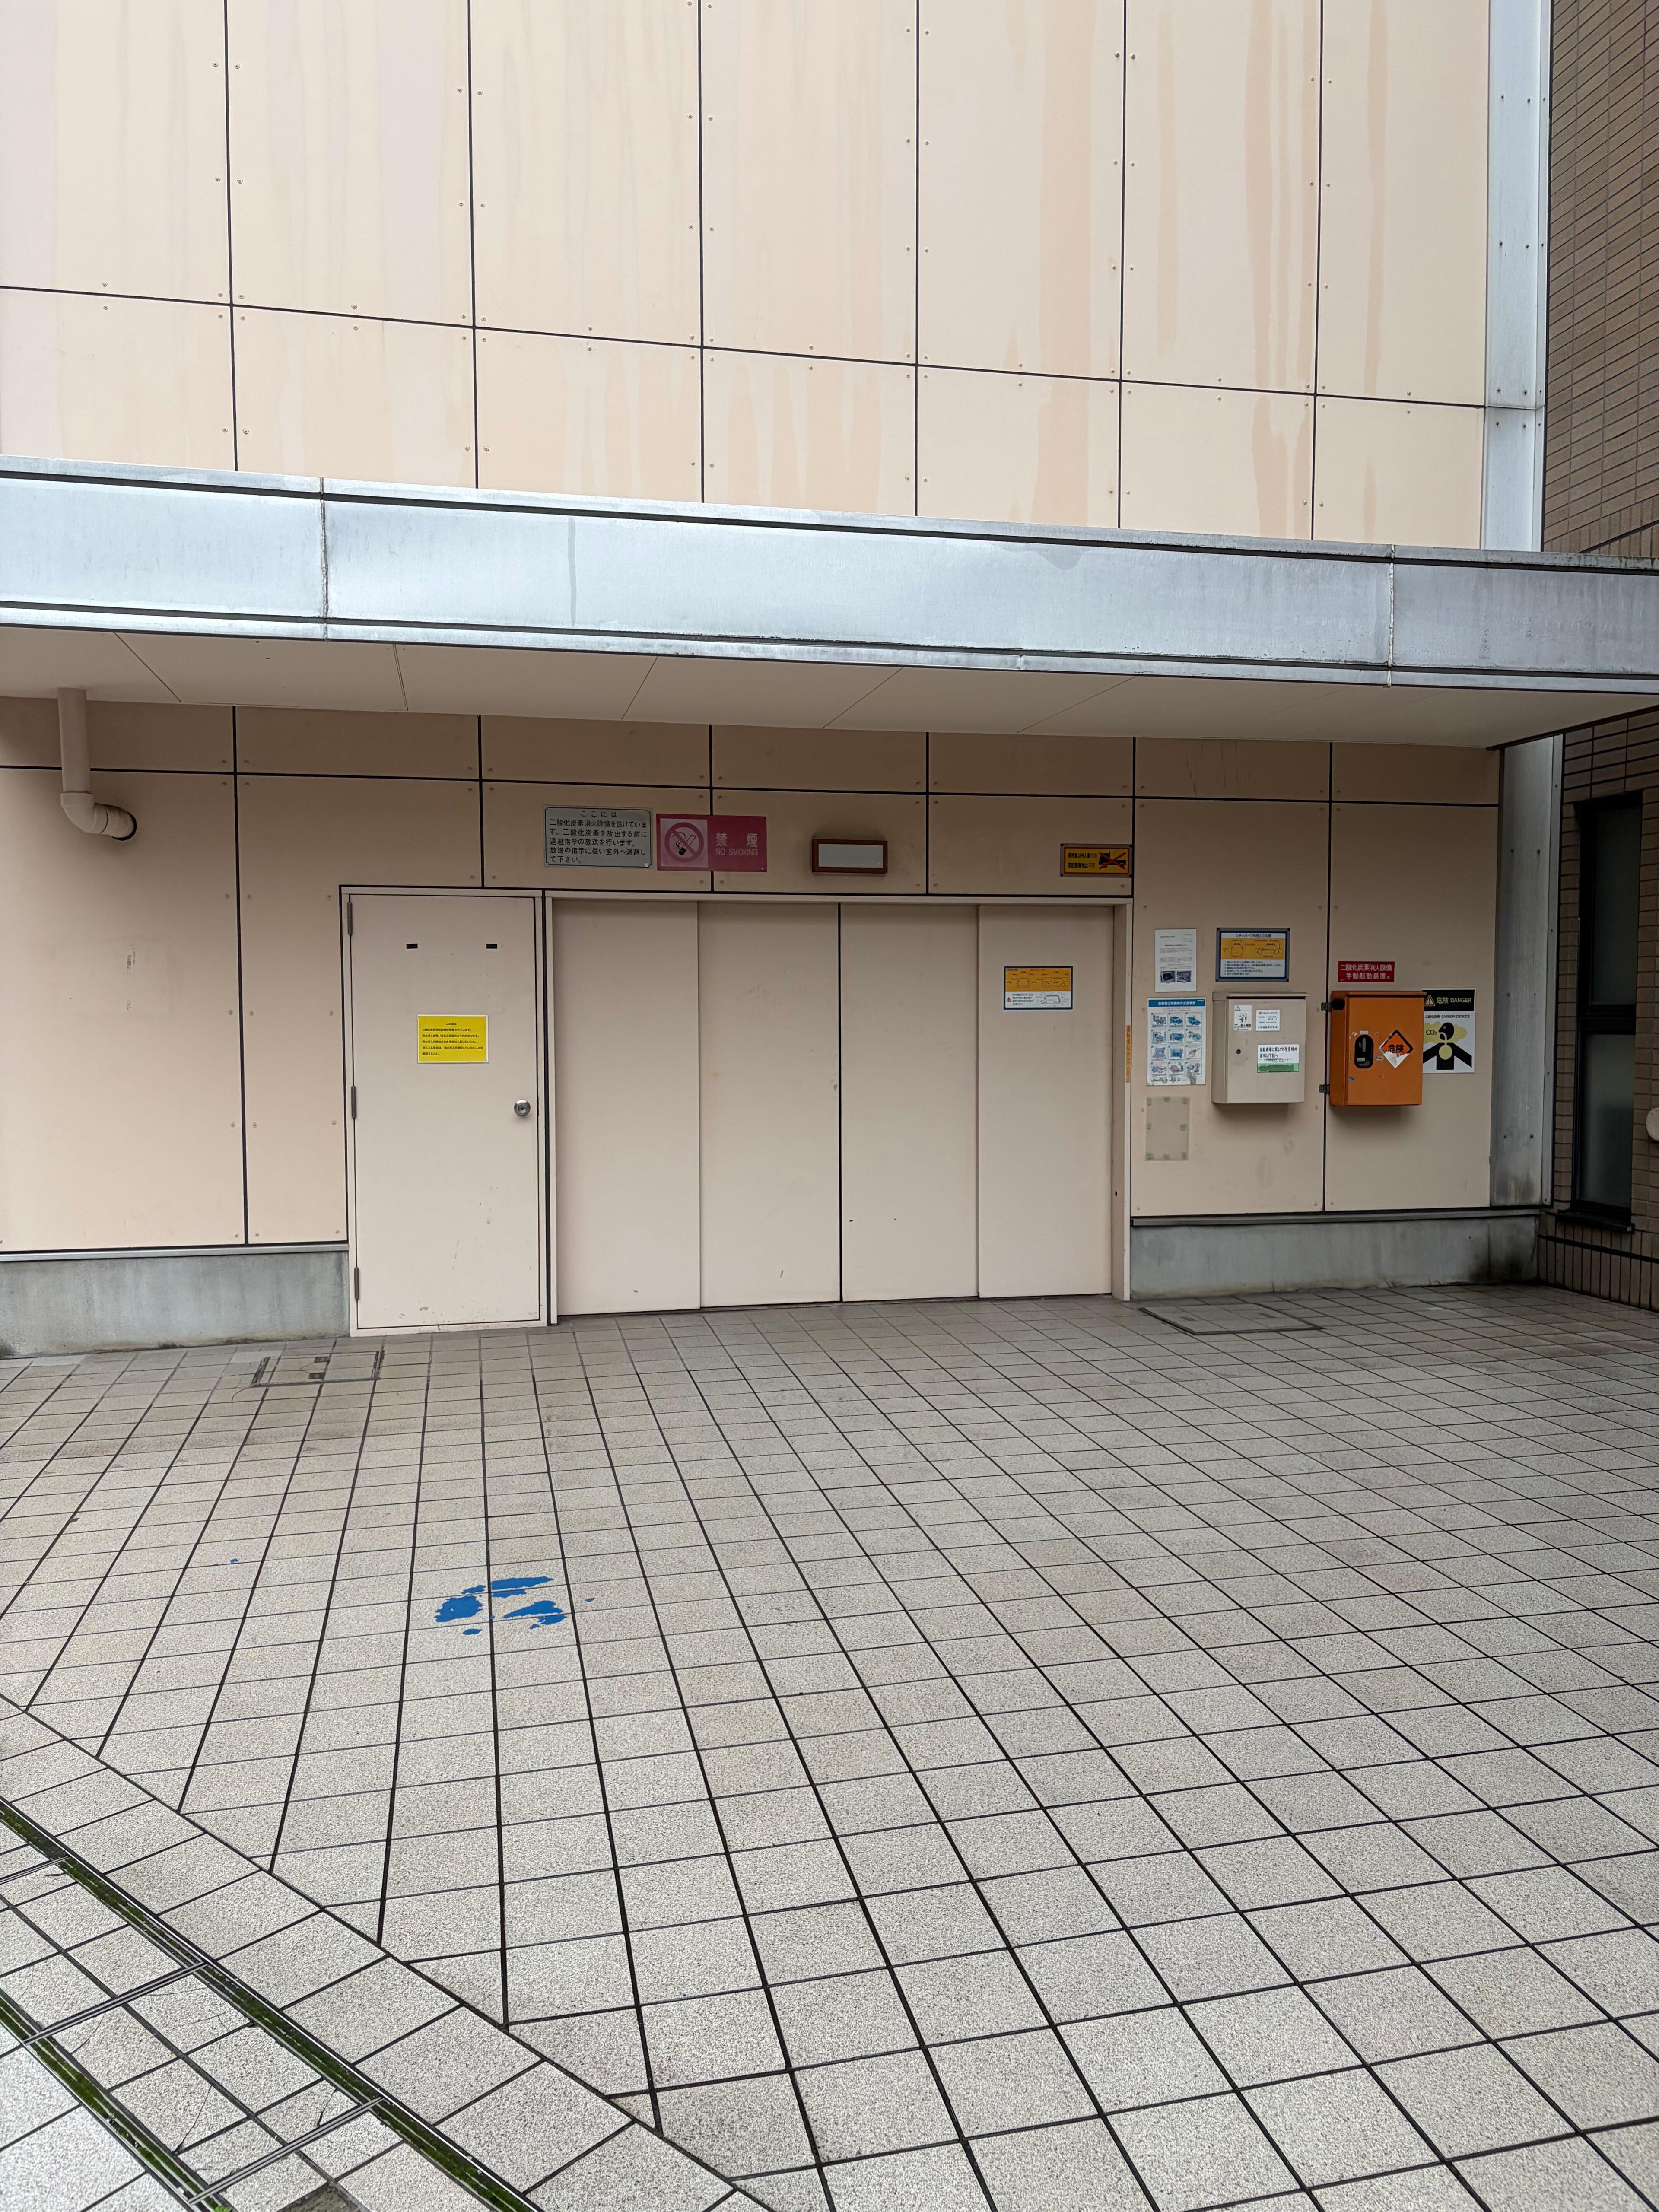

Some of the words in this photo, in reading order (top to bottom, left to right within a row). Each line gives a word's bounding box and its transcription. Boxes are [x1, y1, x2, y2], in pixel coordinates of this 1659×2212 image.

[550, 819, 647, 828] 二酸化炭素消火設備を設けていま
[550, 829, 647, 837] す。二酸化炭素を放出する前に
[550, 838, 635, 847] 退避指令の放送を行います。
[715, 832, 757, 847] 禁煙
[550, 847, 645, 855] 放送の指示に従い室外へ退避し
[1388, 1044, 1404, 1053] 危険
